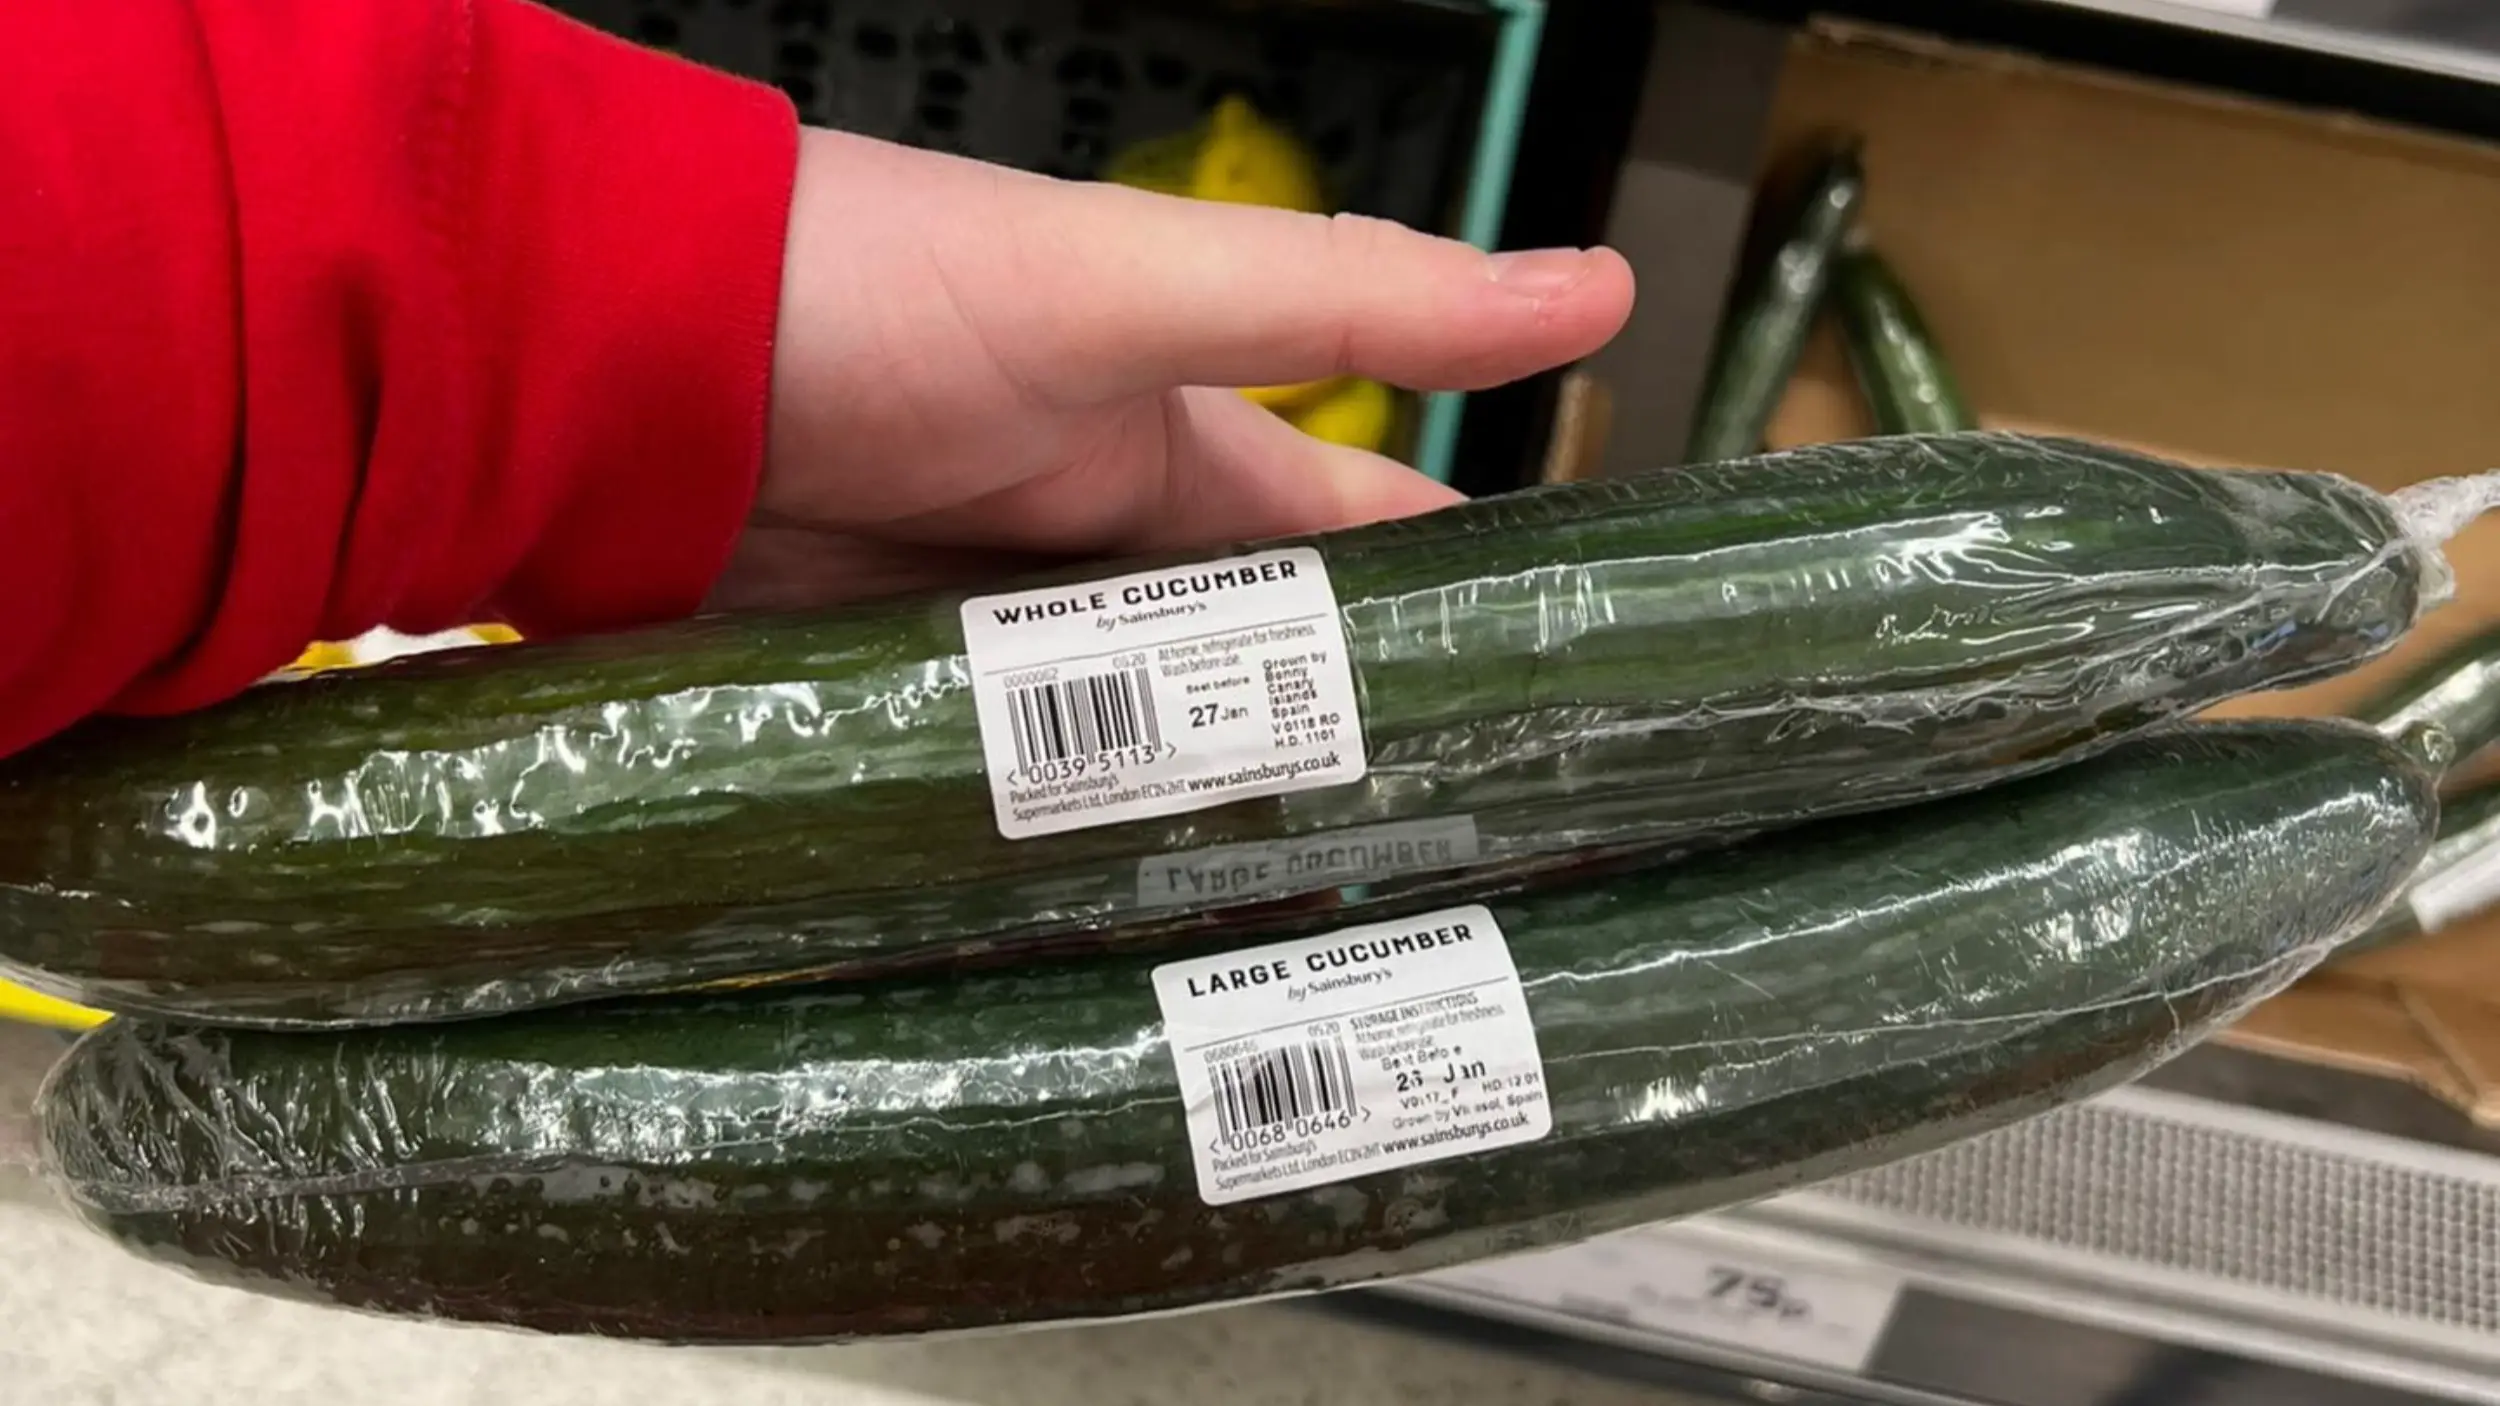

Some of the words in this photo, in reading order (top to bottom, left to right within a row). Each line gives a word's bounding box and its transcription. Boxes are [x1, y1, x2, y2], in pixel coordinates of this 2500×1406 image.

[993, 592, 1107, 625] WHOLE
[1122, 560, 1297, 605] CUCUMBER
[1097, 616, 1116, 632] by
[1118, 600, 1207, 625] Sainsbury's
[1253, 630, 1268, 642] for
[1188, 657, 1219, 673] before
[1262, 655, 1307, 671] Grown
[1311, 651, 1327, 663] by
[1186, 682, 1210, 694] Best
[1213, 676, 1250, 690] before
[1267, 679, 1314, 695] Canary
[1189, 703, 1219, 728] 27
[1220, 706, 1249, 721] Jan
[1271, 703, 1310, 720] Spain
[1306, 728, 1336, 743] 1101
[1029, 757, 1086, 785] 0039
[1099, 745, 1156, 772] 5113
[1188, 750, 1341, 792] www.sainsburys.co.uk
[1010, 786, 1048, 803] Packed
[1050, 782, 1063, 795] for
[1064, 772, 1119, 795] Sainsbury's
[1012, 799, 1082, 822] Supermarkets
[1104, 788, 1141, 805] London
[1187, 960, 1291, 997] LARGE
[1305, 923, 1473, 972] CUCUMBER
[1288, 986, 1306, 1002] by
[1307, 967, 1393, 994] Sainsbury's
[1350, 1007, 1399, 1030] STORAGE
[1417, 1045, 1461, 1062] Befoe
[1443, 1060, 1486, 1083] Jan
[1230, 1123, 1286, 1150] 0068
[1296, 1110, 1351, 1137] 0646
[1382, 1113, 1530, 1155] www.sainsburys.co.uk
[1215, 1168, 1282, 1191] Supermarkets
[1303, 1154, 1339, 1172] London
